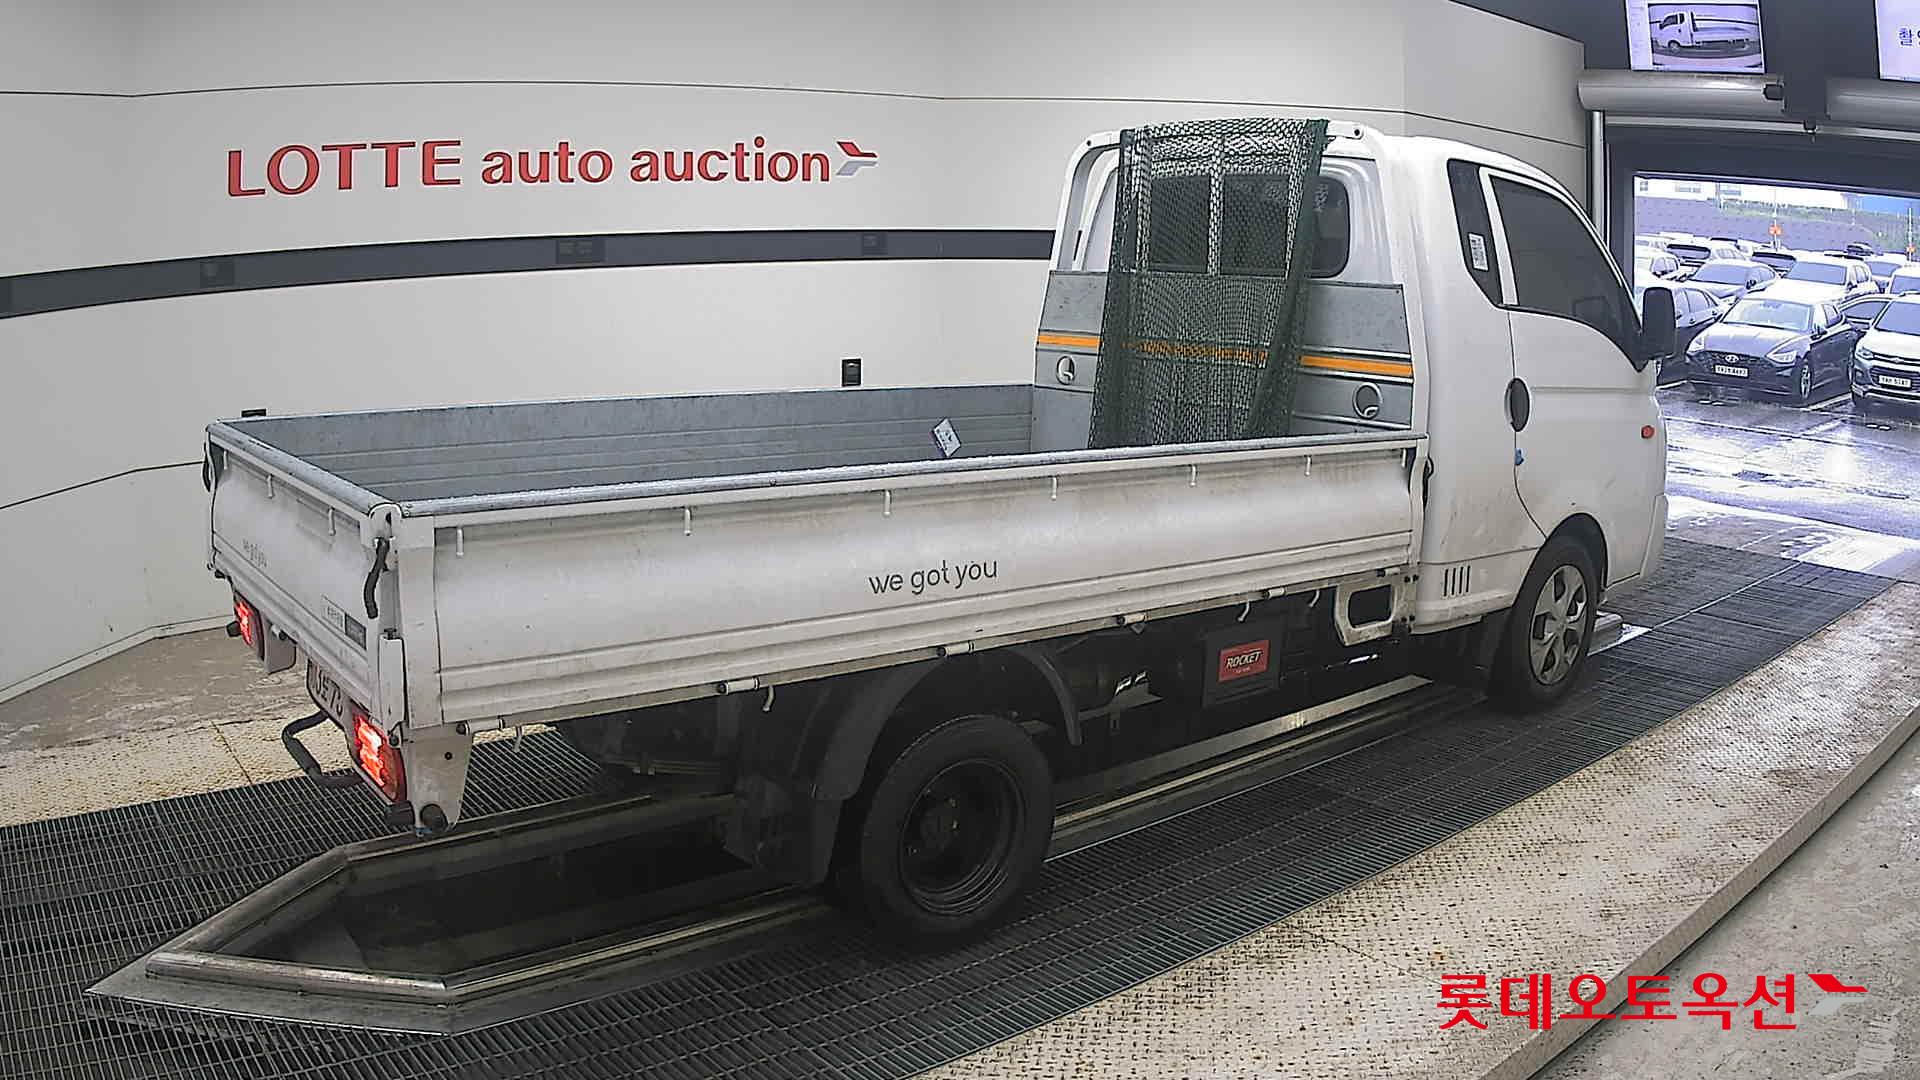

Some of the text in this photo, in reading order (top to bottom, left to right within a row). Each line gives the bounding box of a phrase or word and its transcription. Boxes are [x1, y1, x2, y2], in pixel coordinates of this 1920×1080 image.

[228, 136, 830, 197] LOTTE auto auction
[868, 559, 998, 596] we got you
[1226, 650, 1263, 669] ROCKET
